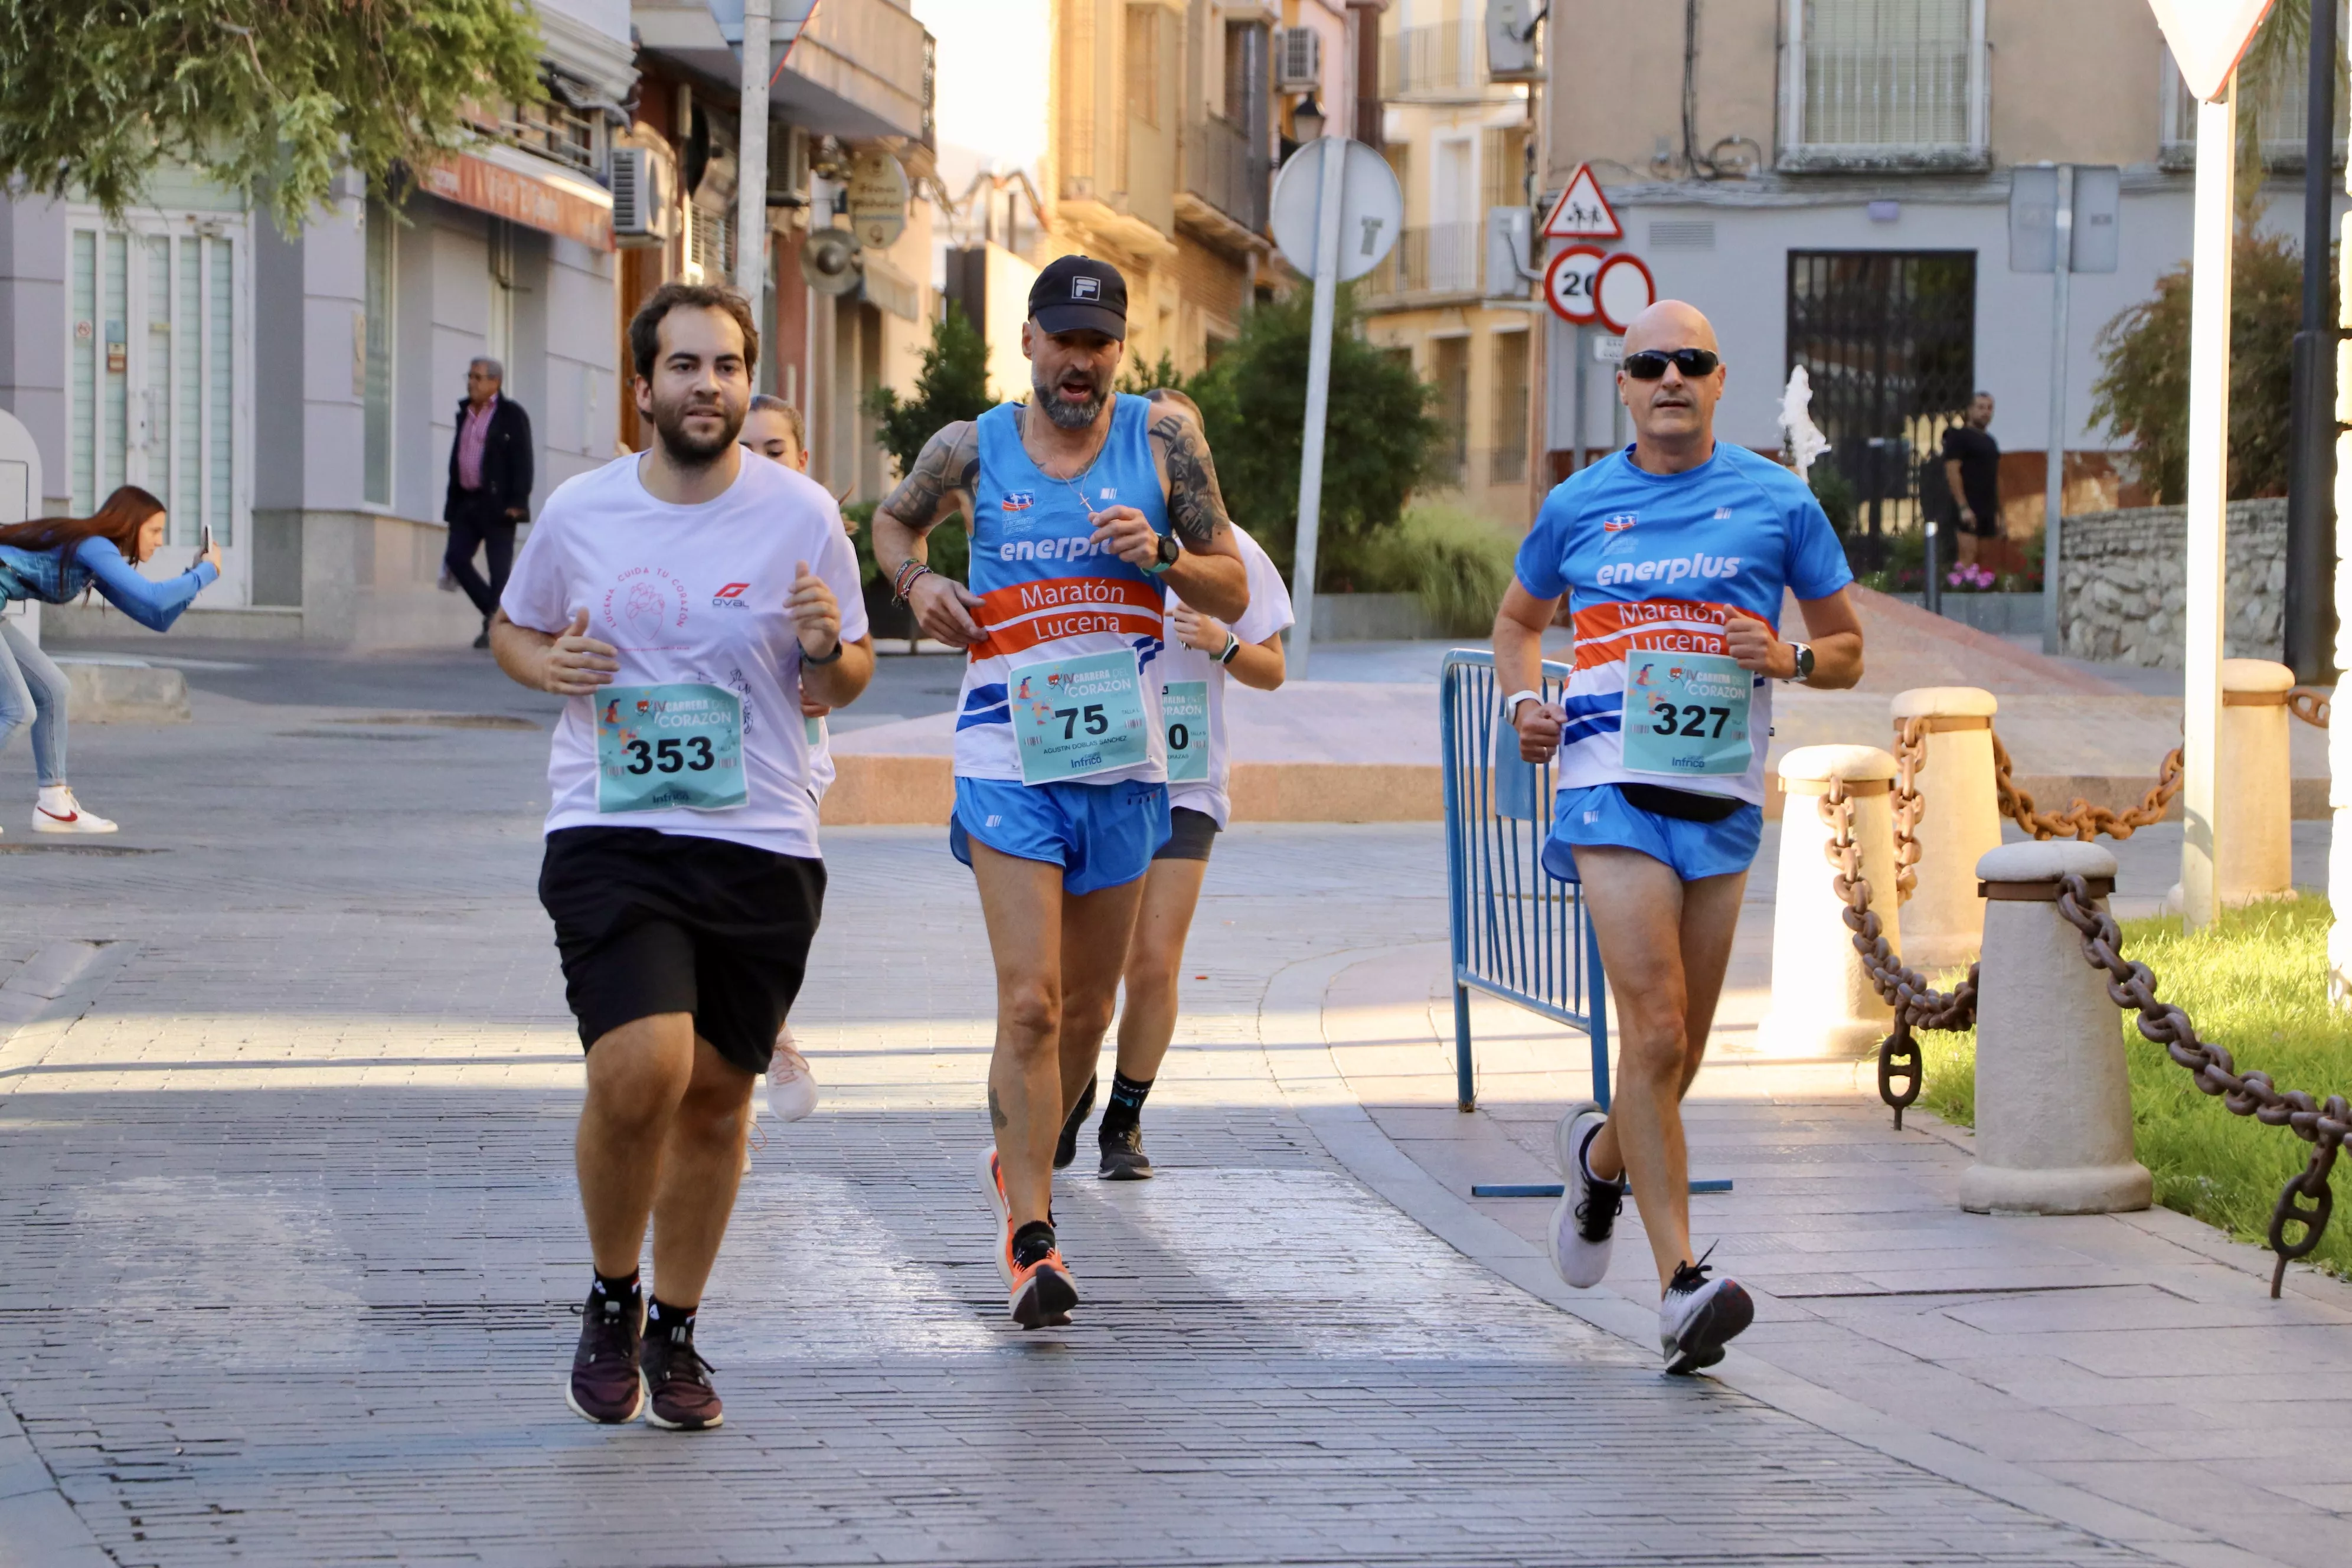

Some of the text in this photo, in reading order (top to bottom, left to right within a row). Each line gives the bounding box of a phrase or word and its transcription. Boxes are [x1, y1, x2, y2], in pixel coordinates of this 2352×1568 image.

[1596, 553, 1740, 586] enerplus
[604, 588, 617, 628] LUCENA
[618, 567, 649, 582] CUIDA
[657, 568, 669, 577] TU
[1021, 579, 1125, 609] Maratón
[1033, 616, 1119, 640] Lucena
[1618, 603, 1725, 626] Maratón
[1055, 704, 1108, 740] 75
[1652, 703, 1730, 739] 327
[627, 736, 714, 775] 353
[1044, 745, 1070, 754] AGUSTIN
[1072, 741, 1097, 749] DOBLAS
[1071, 757, 1102, 768] Infrico
